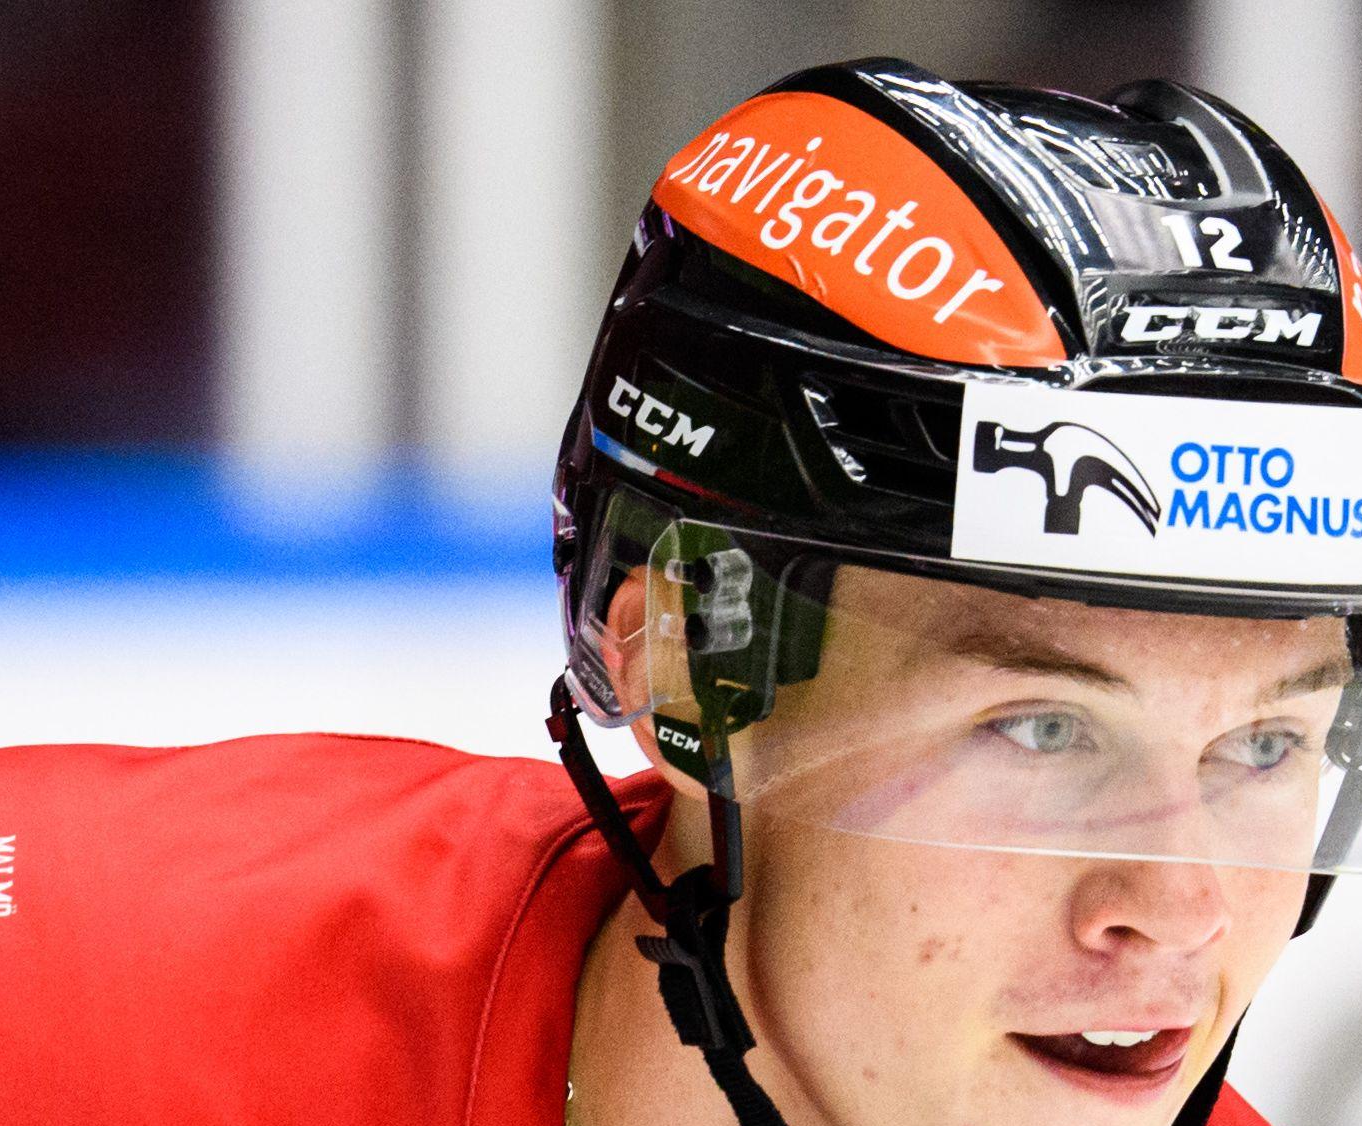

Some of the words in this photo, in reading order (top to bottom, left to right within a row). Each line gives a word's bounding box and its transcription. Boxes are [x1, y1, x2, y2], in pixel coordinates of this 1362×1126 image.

[669, 129, 1005, 324] navigator
[1160, 213, 1254, 273] 12
[1120, 305, 1323, 347] CCM
[607, 375, 716, 457] CCM
[1169, 441, 1295, 489] OTTO
[657, 725, 701, 753] CCM
